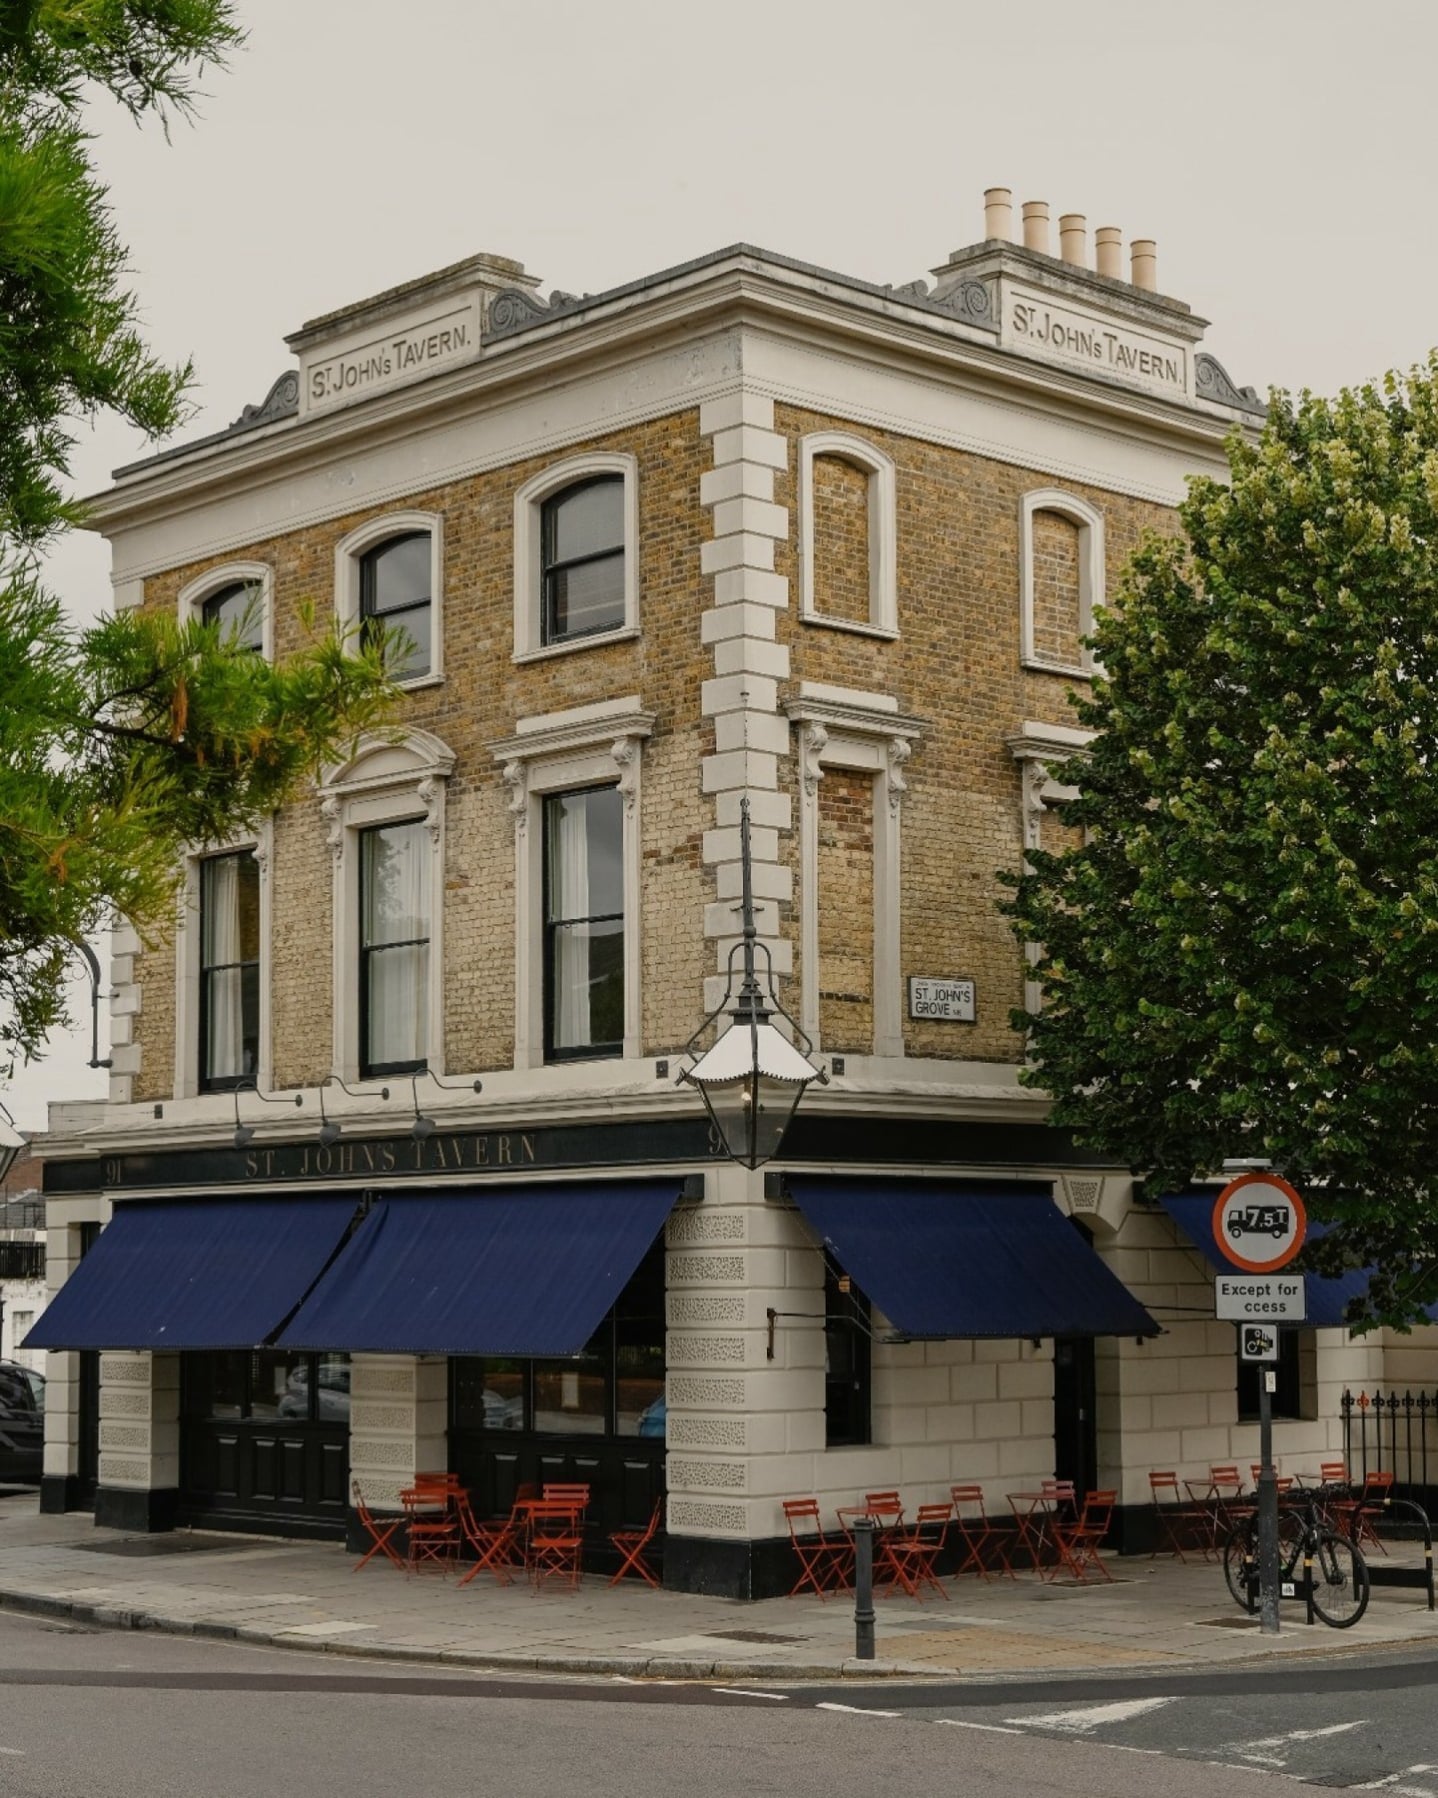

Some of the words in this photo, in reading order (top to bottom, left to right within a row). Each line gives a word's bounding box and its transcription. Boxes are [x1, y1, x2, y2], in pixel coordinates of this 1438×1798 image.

[392, 324, 471, 370] TAVERN.
[934, 989, 971, 1003] JOHN'S
[915, 1001, 950, 1016] GROVE
[245, 1150, 286, 1177] ST.
[410, 1134, 538, 1169] TAVERN
[1221, 1283, 1271, 1298] Except
[1278, 1283, 1298, 1296] for
